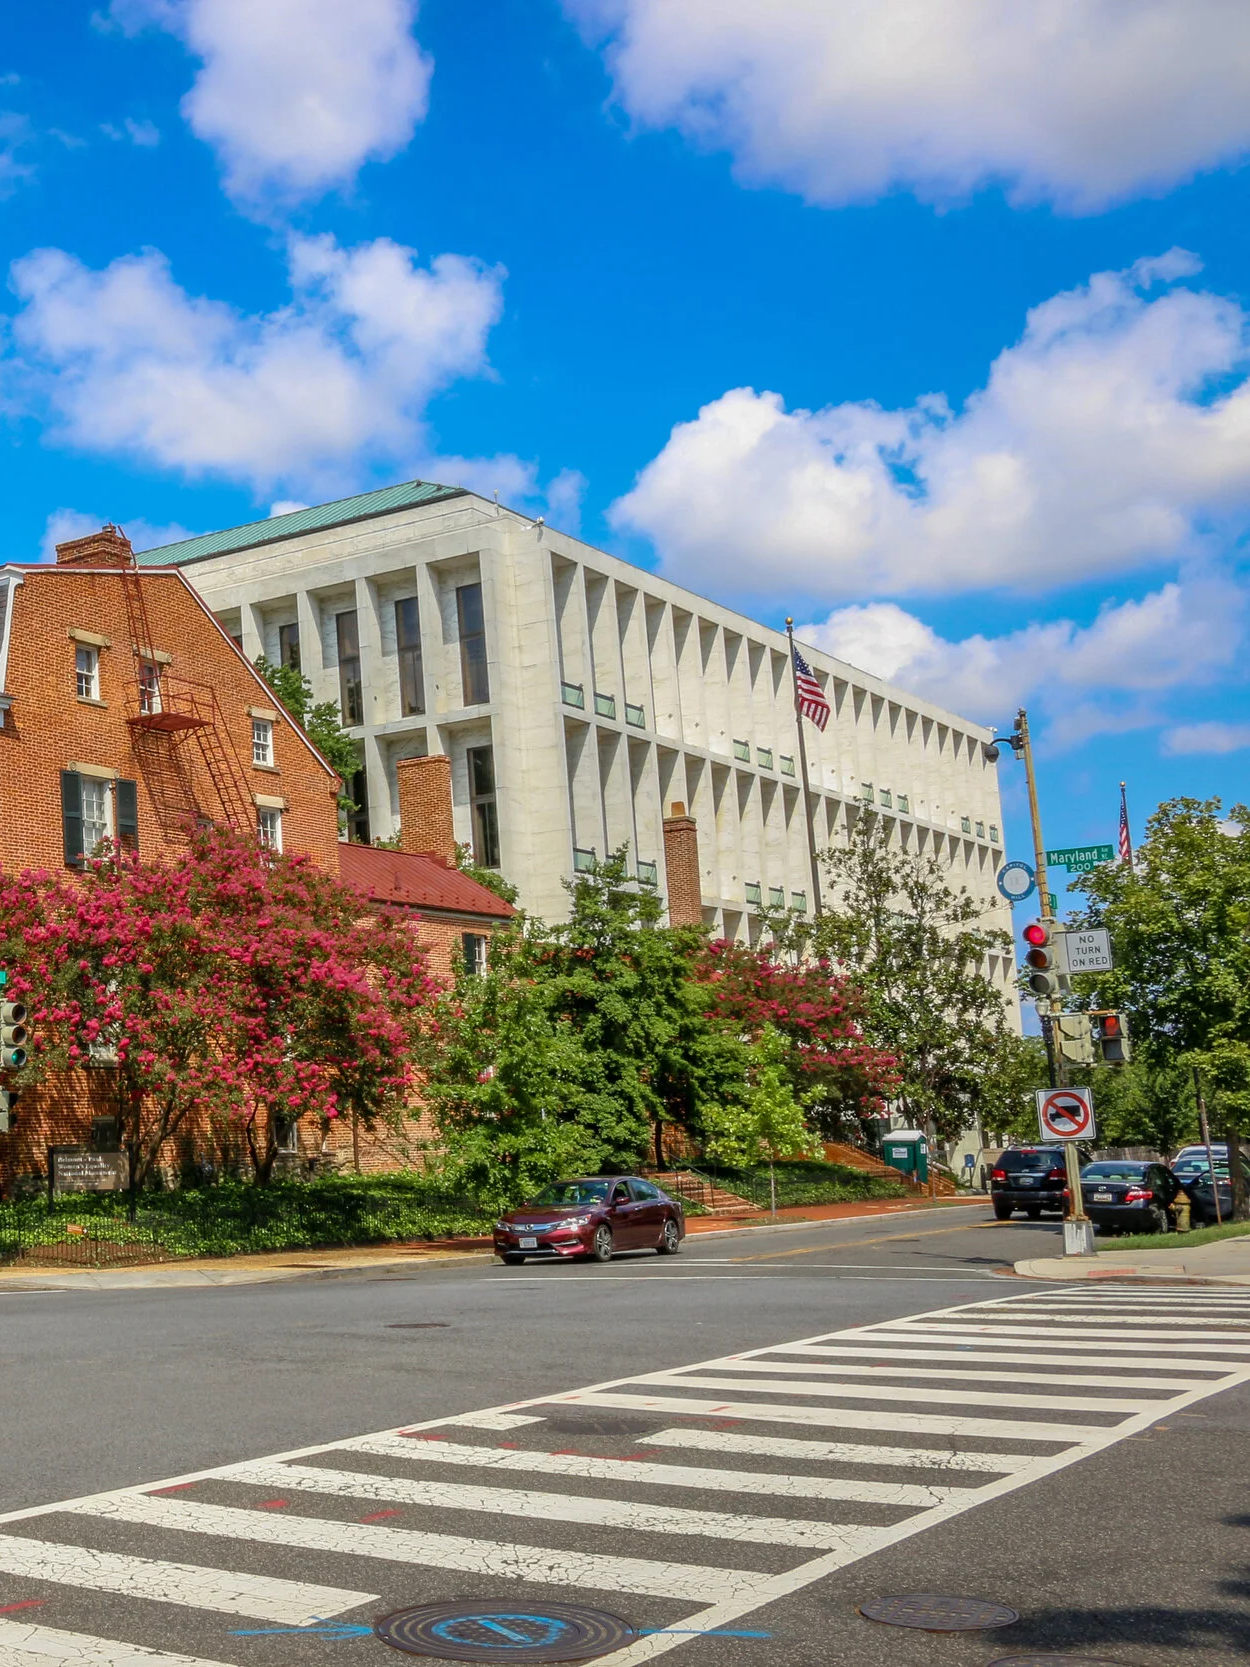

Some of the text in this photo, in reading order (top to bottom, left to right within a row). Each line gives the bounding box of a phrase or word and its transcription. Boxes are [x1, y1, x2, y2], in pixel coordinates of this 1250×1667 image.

[1050, 849, 1098, 864] Maryland
[1002, 862, 1028, 873] CAPITOL
[1070, 862, 1091, 872] 200
[1079, 935, 1095, 944] NO
[1075, 945, 1101, 955] TURN
[1072, 956, 1108, 967] ON RED
